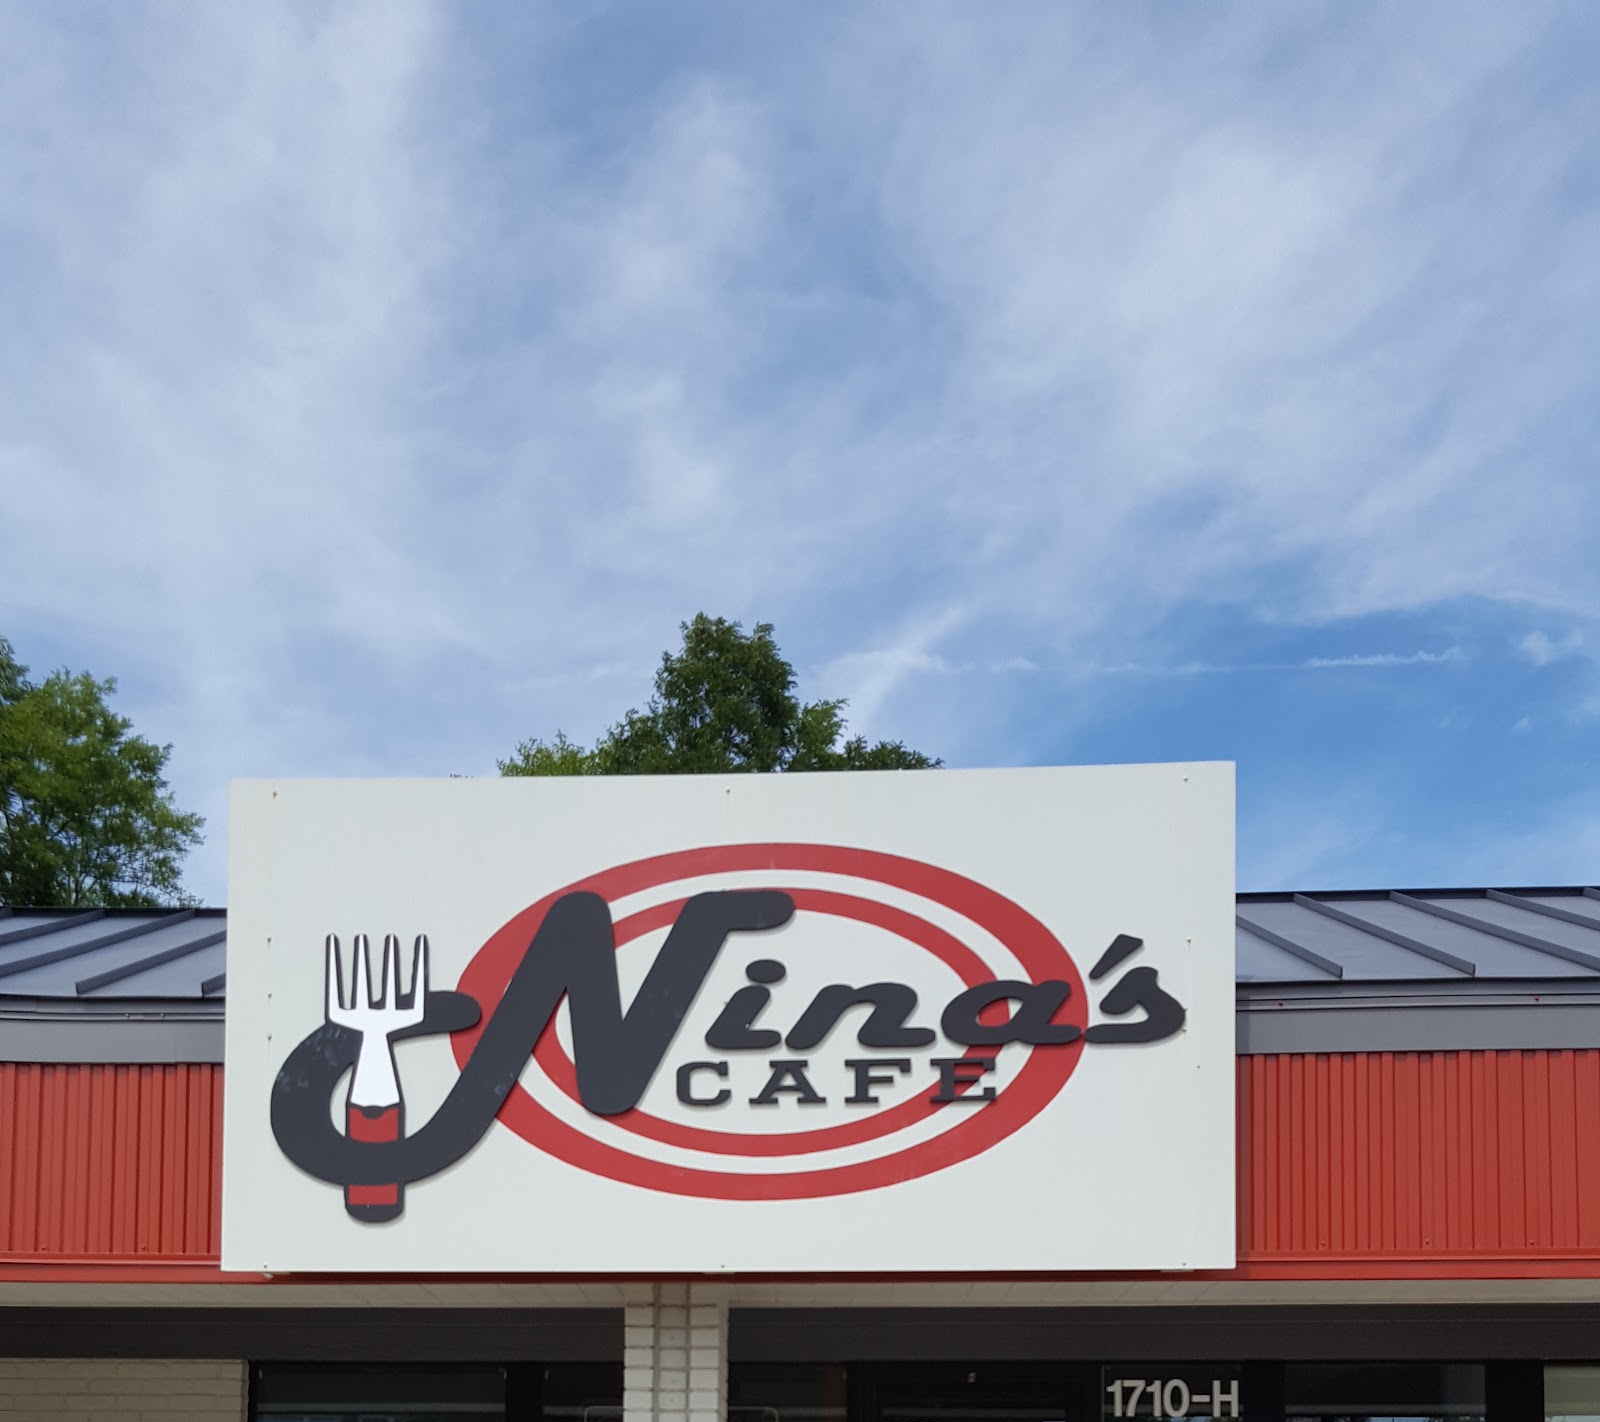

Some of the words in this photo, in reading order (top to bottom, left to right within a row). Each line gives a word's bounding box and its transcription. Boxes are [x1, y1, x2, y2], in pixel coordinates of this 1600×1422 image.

[270, 890, 1185, 1187] Nina's
[675, 1057, 999, 1106] CAFE
[1106, 1378, 1239, 1417] 1710-H
